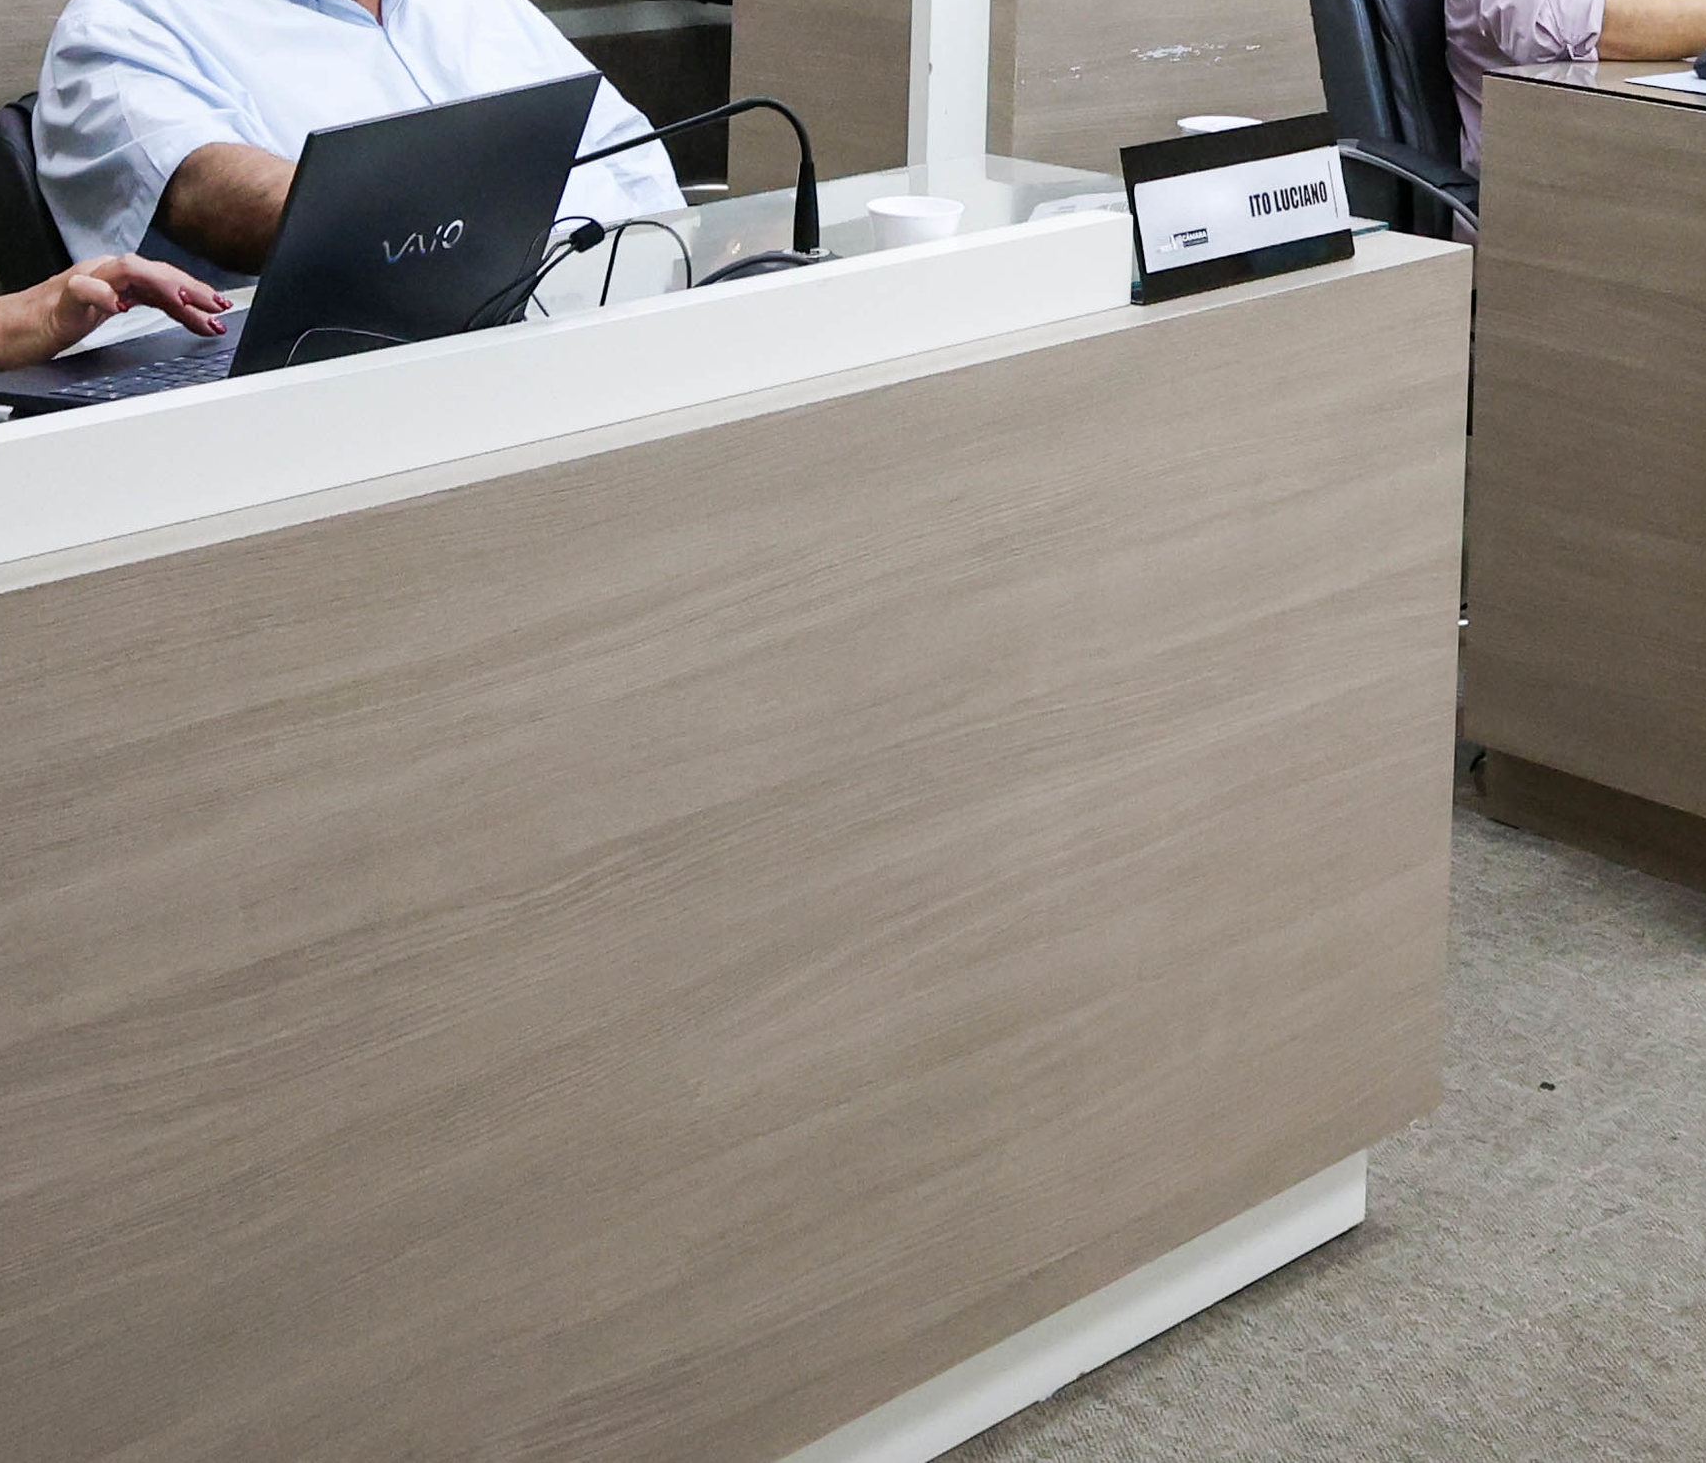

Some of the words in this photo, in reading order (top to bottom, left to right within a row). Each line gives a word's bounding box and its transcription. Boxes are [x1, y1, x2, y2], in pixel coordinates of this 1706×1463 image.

[1249, 193, 1272, 218] ITO
[1273, 180, 1329, 213] LUCIANO
[382, 219, 464, 264] VAIO
